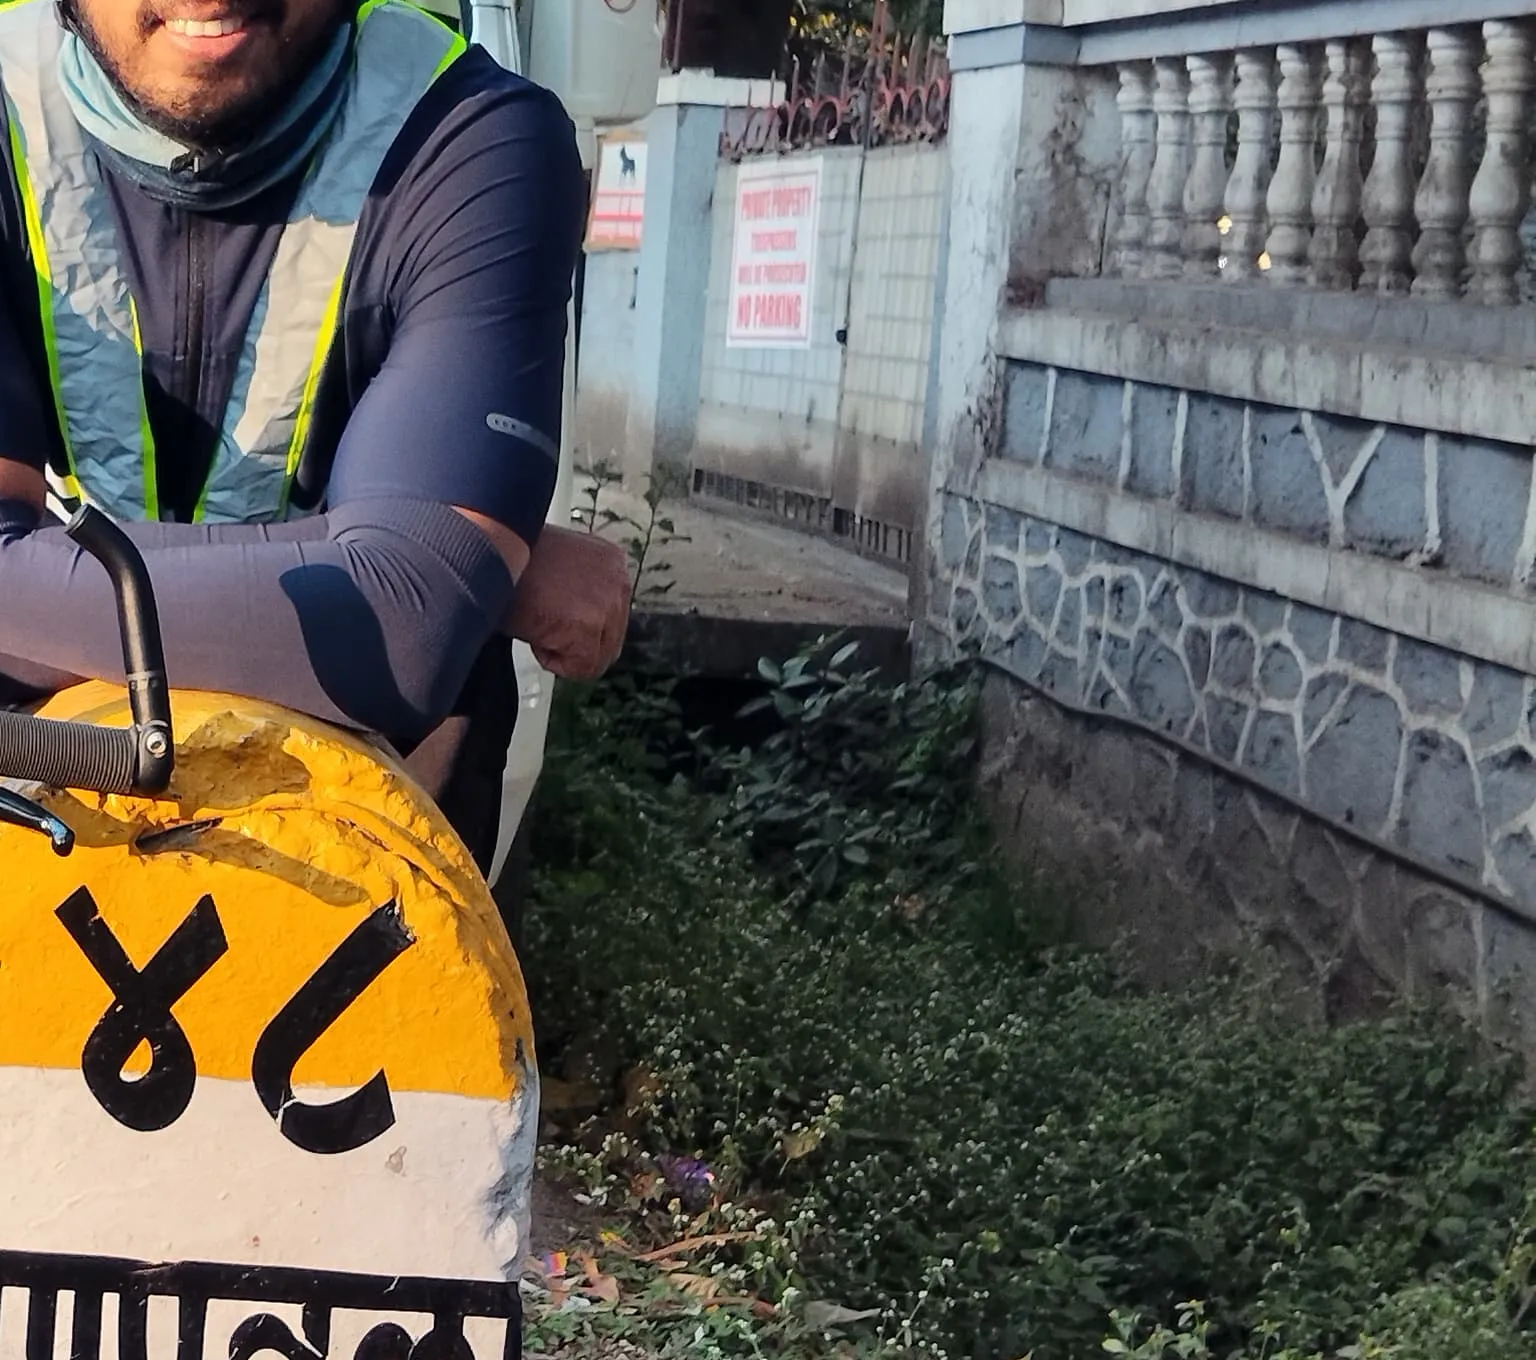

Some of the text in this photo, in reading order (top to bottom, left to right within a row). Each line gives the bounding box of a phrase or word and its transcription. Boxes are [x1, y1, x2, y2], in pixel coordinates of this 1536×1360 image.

[737, 294, 802, 328] NO PARKING
[56, 886, 415, 1154] ४८
